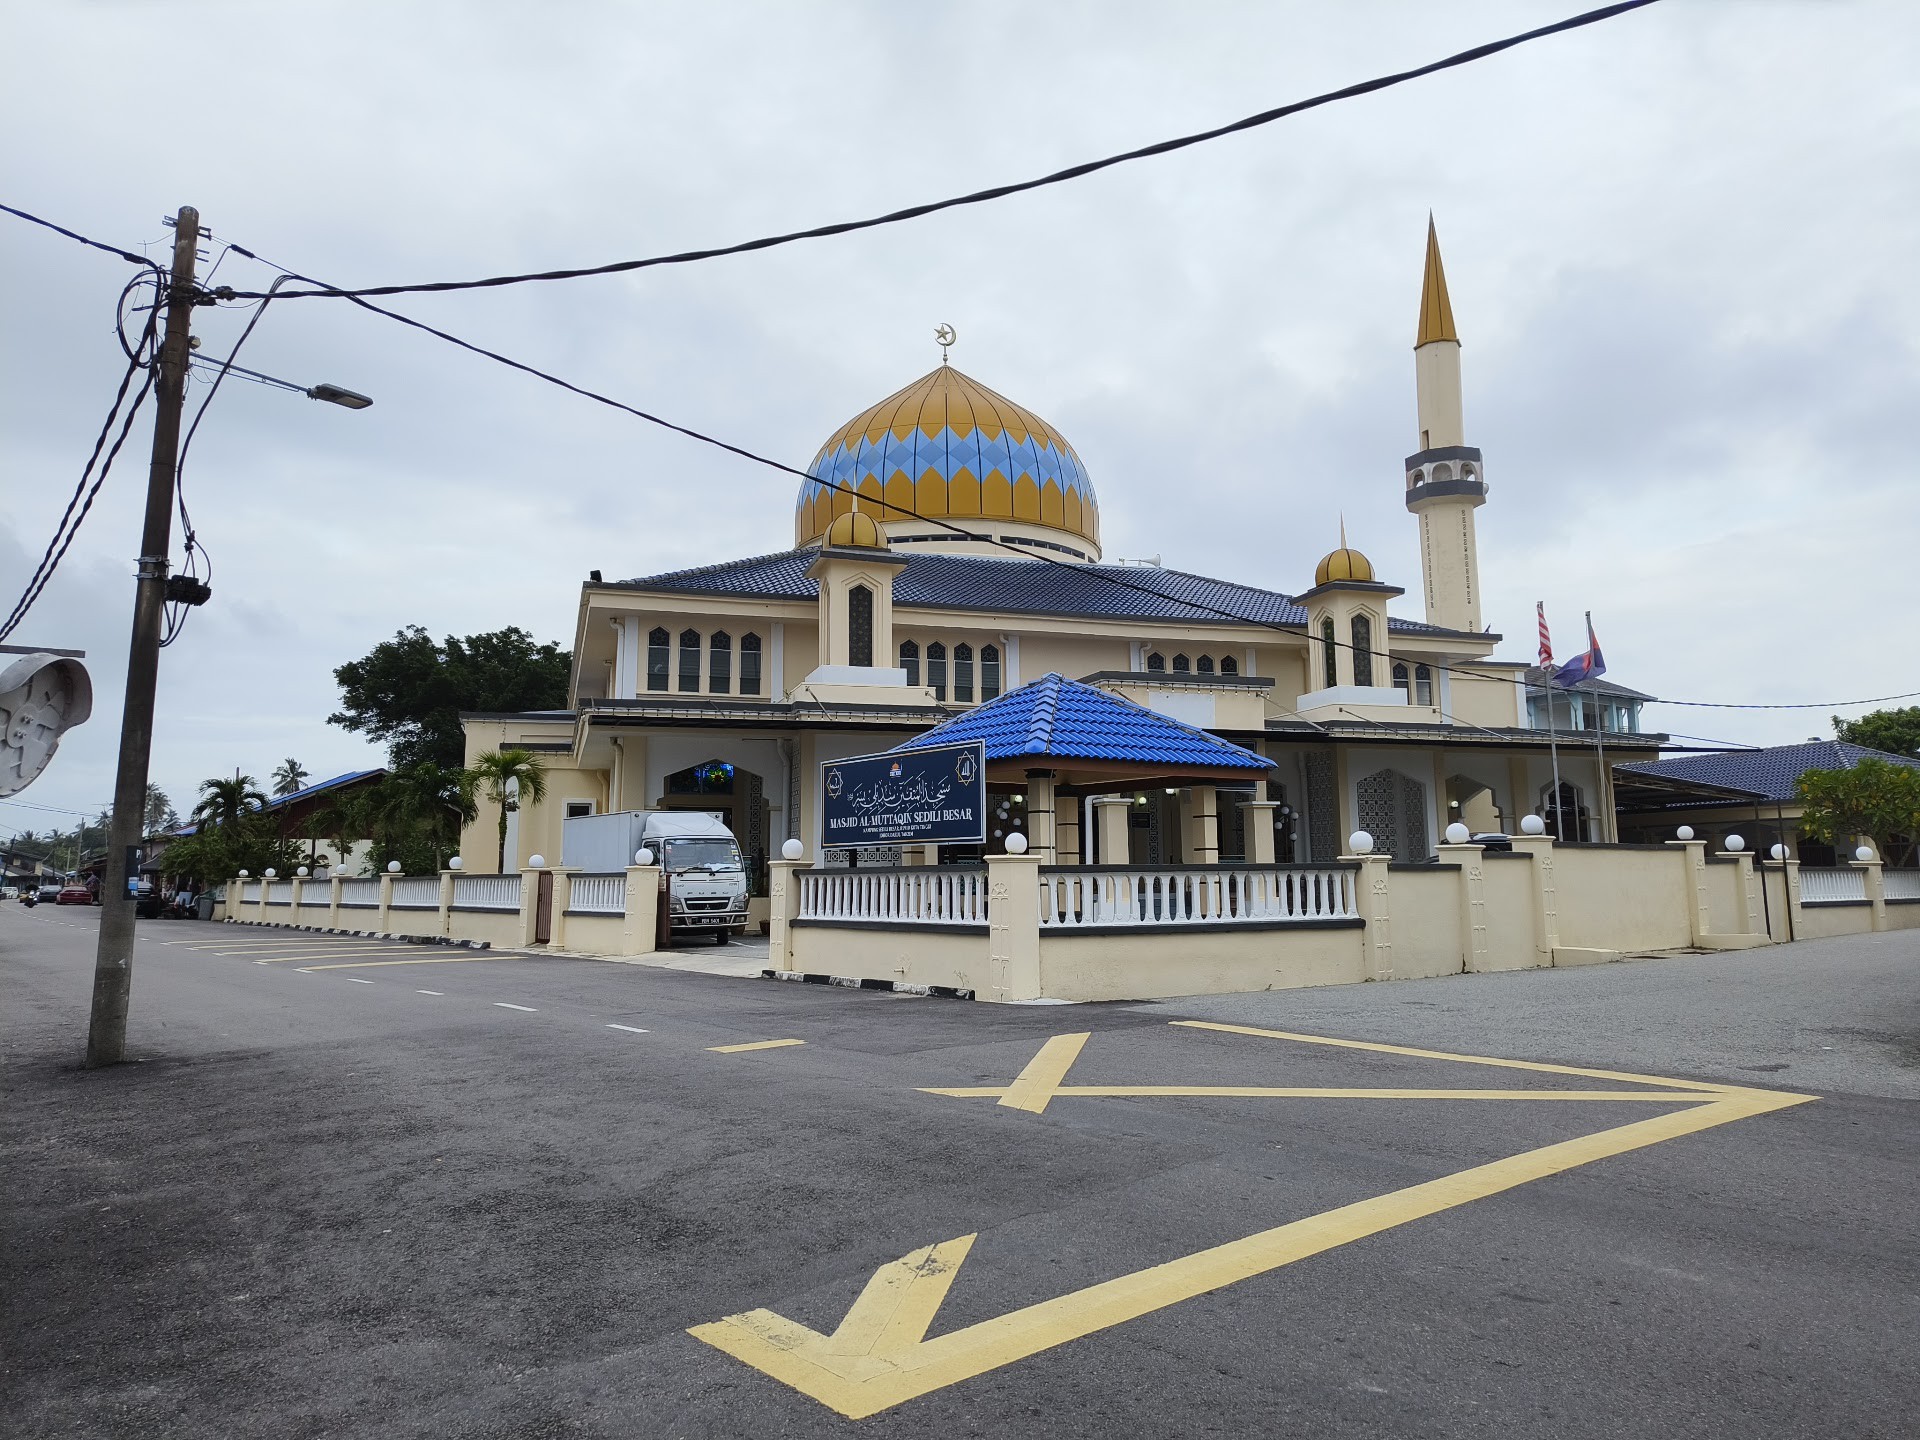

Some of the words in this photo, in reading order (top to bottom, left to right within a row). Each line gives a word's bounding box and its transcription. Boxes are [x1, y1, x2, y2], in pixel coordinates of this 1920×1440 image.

[830, 816, 858, 829] MASJID
[859, 812, 913, 826] AL-MUTTAQIN
[913, 810, 941, 823] SEDILI
[943, 808, 973, 821] BESAR
